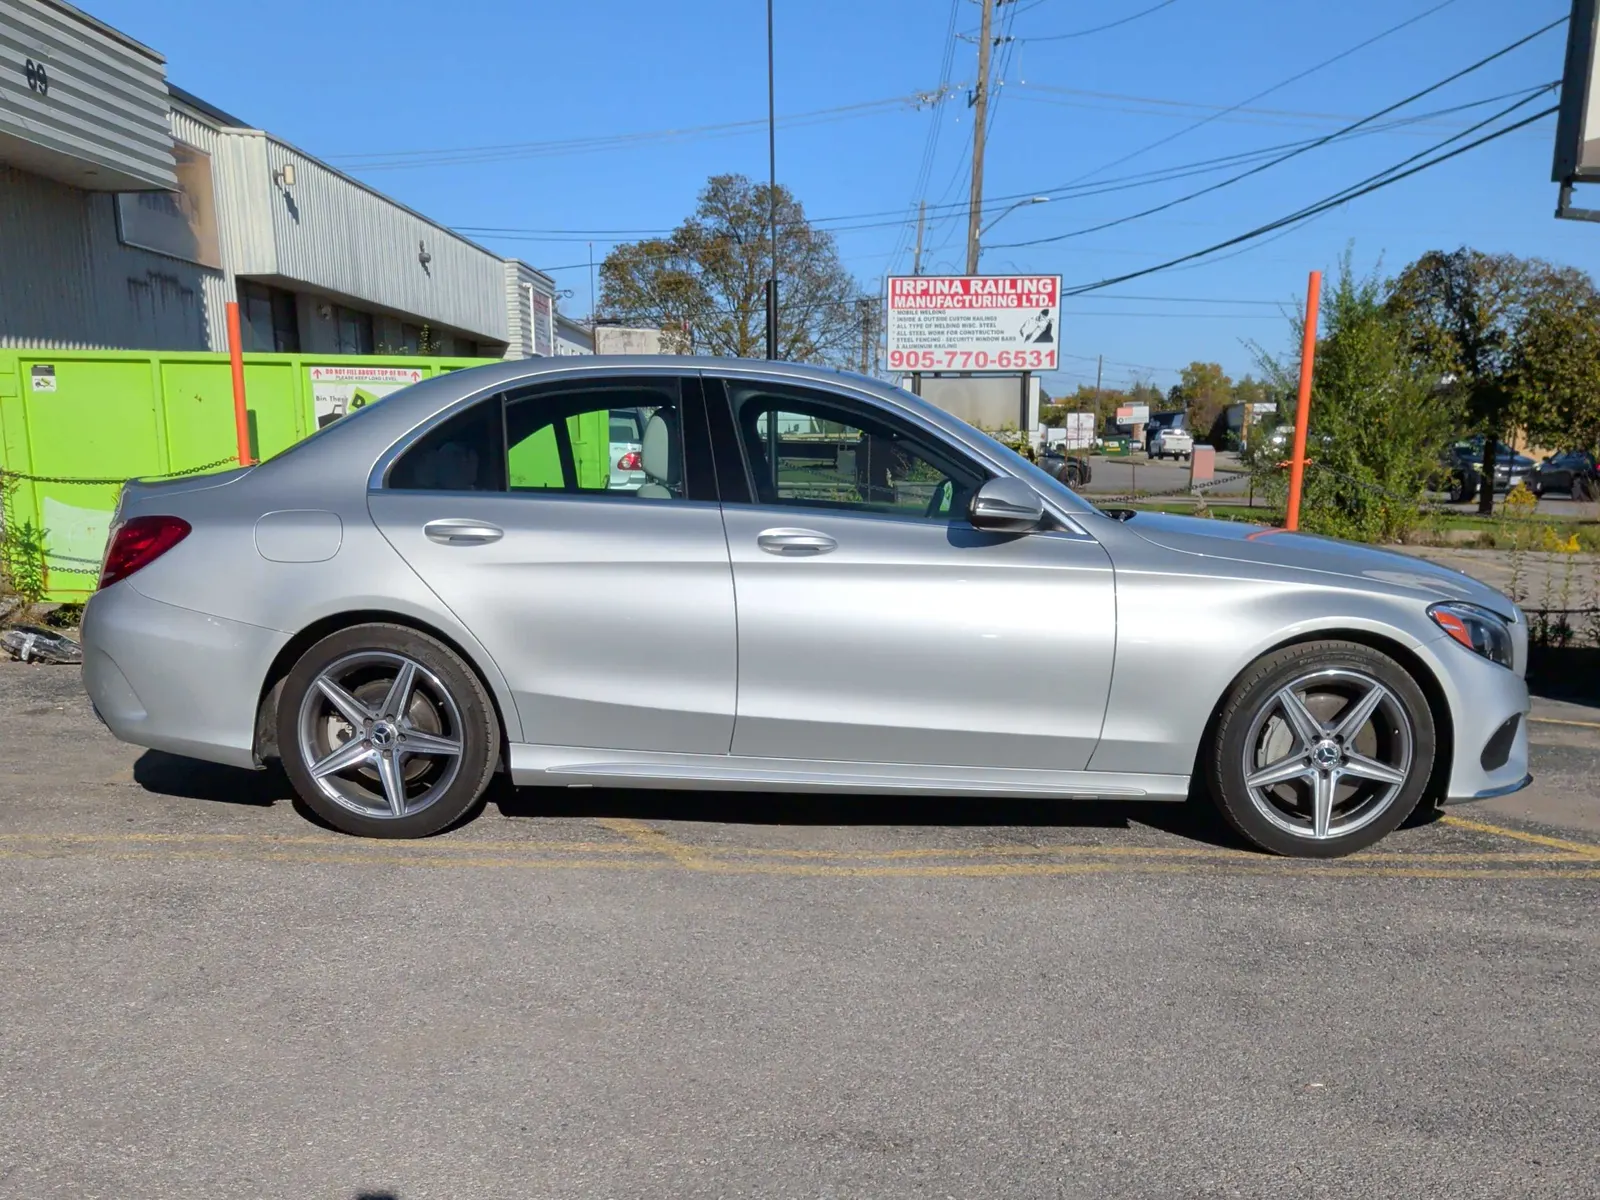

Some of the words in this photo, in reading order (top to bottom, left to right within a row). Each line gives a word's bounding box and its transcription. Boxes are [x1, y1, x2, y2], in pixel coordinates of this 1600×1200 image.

[895, 280, 964, 294] IRPINA
[970, 278, 1052, 294] RAILING
[894, 295, 1018, 308] MANUFACTURING
[1022, 294, 1053, 307] LTD.
[890, 349, 1056, 368] 905-770-6531
